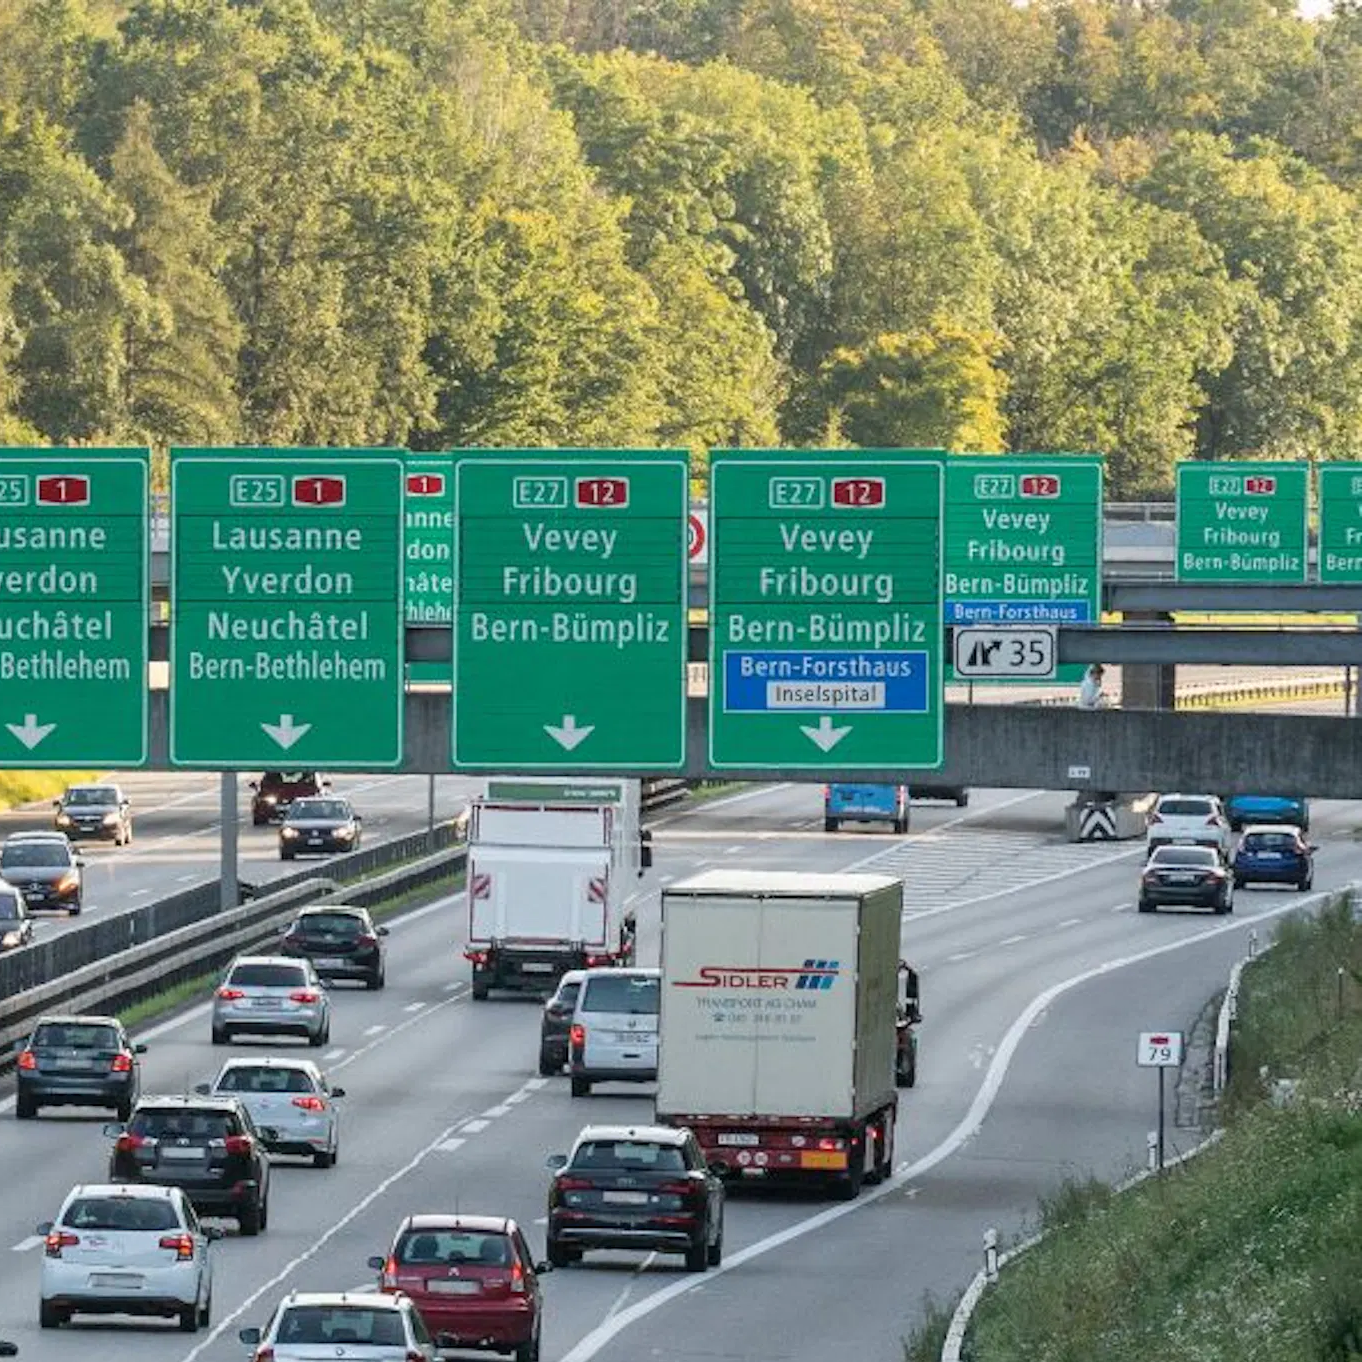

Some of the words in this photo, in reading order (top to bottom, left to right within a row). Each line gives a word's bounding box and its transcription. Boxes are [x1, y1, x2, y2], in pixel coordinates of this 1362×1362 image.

[57, 480, 67, 501] 1
[237, 480, 278, 501] E25
[313, 481, 323, 502] 1
[420, 476, 429, 493] 1
[520, 482, 558, 501] E27
[589, 482, 613, 503] 12
[777, 484, 815, 503] E27
[846, 483, 870, 503] 12
[980, 479, 1008, 495] E27
[1030, 479, 1051, 495] 12
[983, 509, 1049, 533] Vevey
[1215, 502, 1269, 524] Vevey
[214, 522, 361, 549] Lausanne
[524, 523, 616, 558] Vevey
[781, 525, 872, 558] Vevey
[1204, 527, 1280, 548] Fribourg
[969, 540, 1064, 565] Fribourg
[1183, 552, 1299, 573] Bern-Bümpliz
[223, 565, 351, 593] Yverdon
[504, 567, 636, 603] Fribourg
[761, 567, 892, 603] Fribourg
[945, 573, 1087, 598] Bern-Bümpliz
[955, 604, 1076, 618] Bern-Forsthaus
[209, 611, 366, 639] Neuchâtel
[473, 613, 668, 648] Bern-Bümpliz
[730, 614, 924, 648] Bern-Bümpliz
[1011, 641, 1043, 666] 35
[191, 652, 384, 679] Bern-Bethlehem
[741, 656, 910, 676] Bern-Forsthaus
[777, 685, 875, 705] Inselspital
[672, 967, 789, 989] SIDLER
[1149, 1047, 1171, 1061] 79
